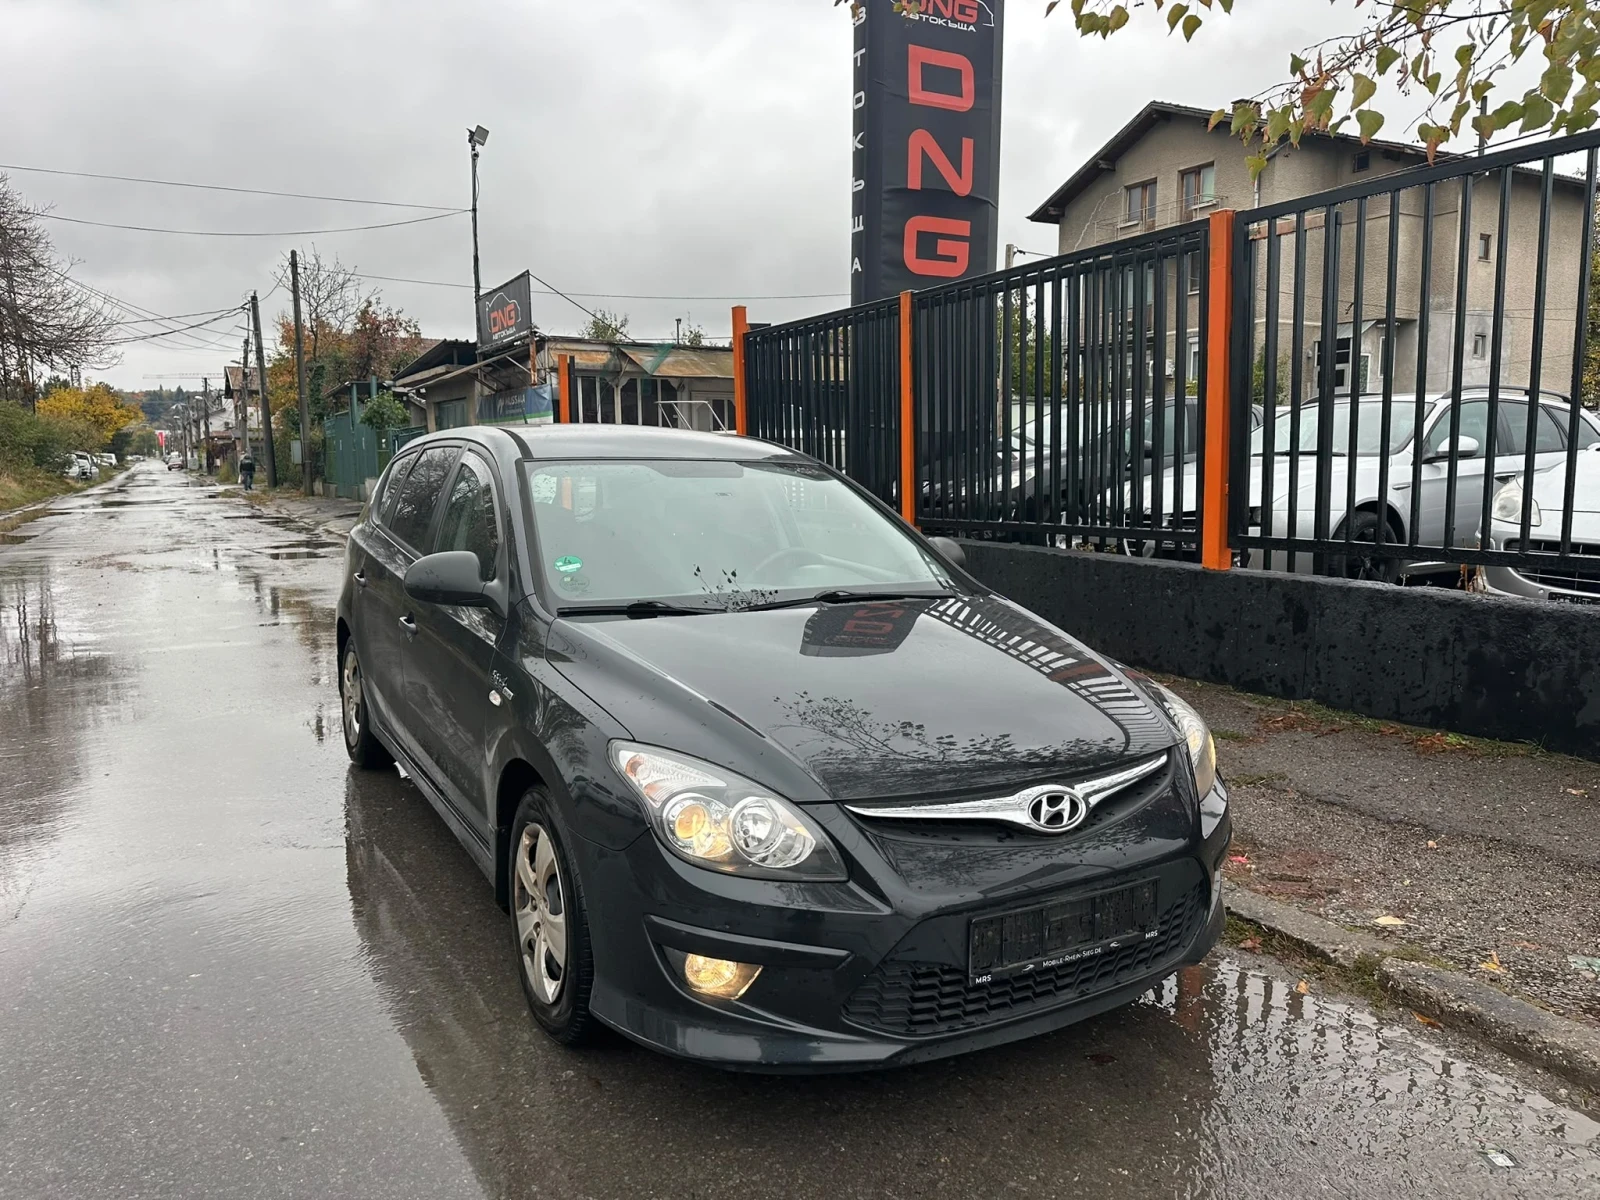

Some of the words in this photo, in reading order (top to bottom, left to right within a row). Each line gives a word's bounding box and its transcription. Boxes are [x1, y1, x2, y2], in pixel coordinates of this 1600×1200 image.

[904, 43, 975, 278] DNG
[490, 303, 515, 333] DNG
[1145, 930, 1158, 940] MRS
[975, 974, 992, 985] MRS
